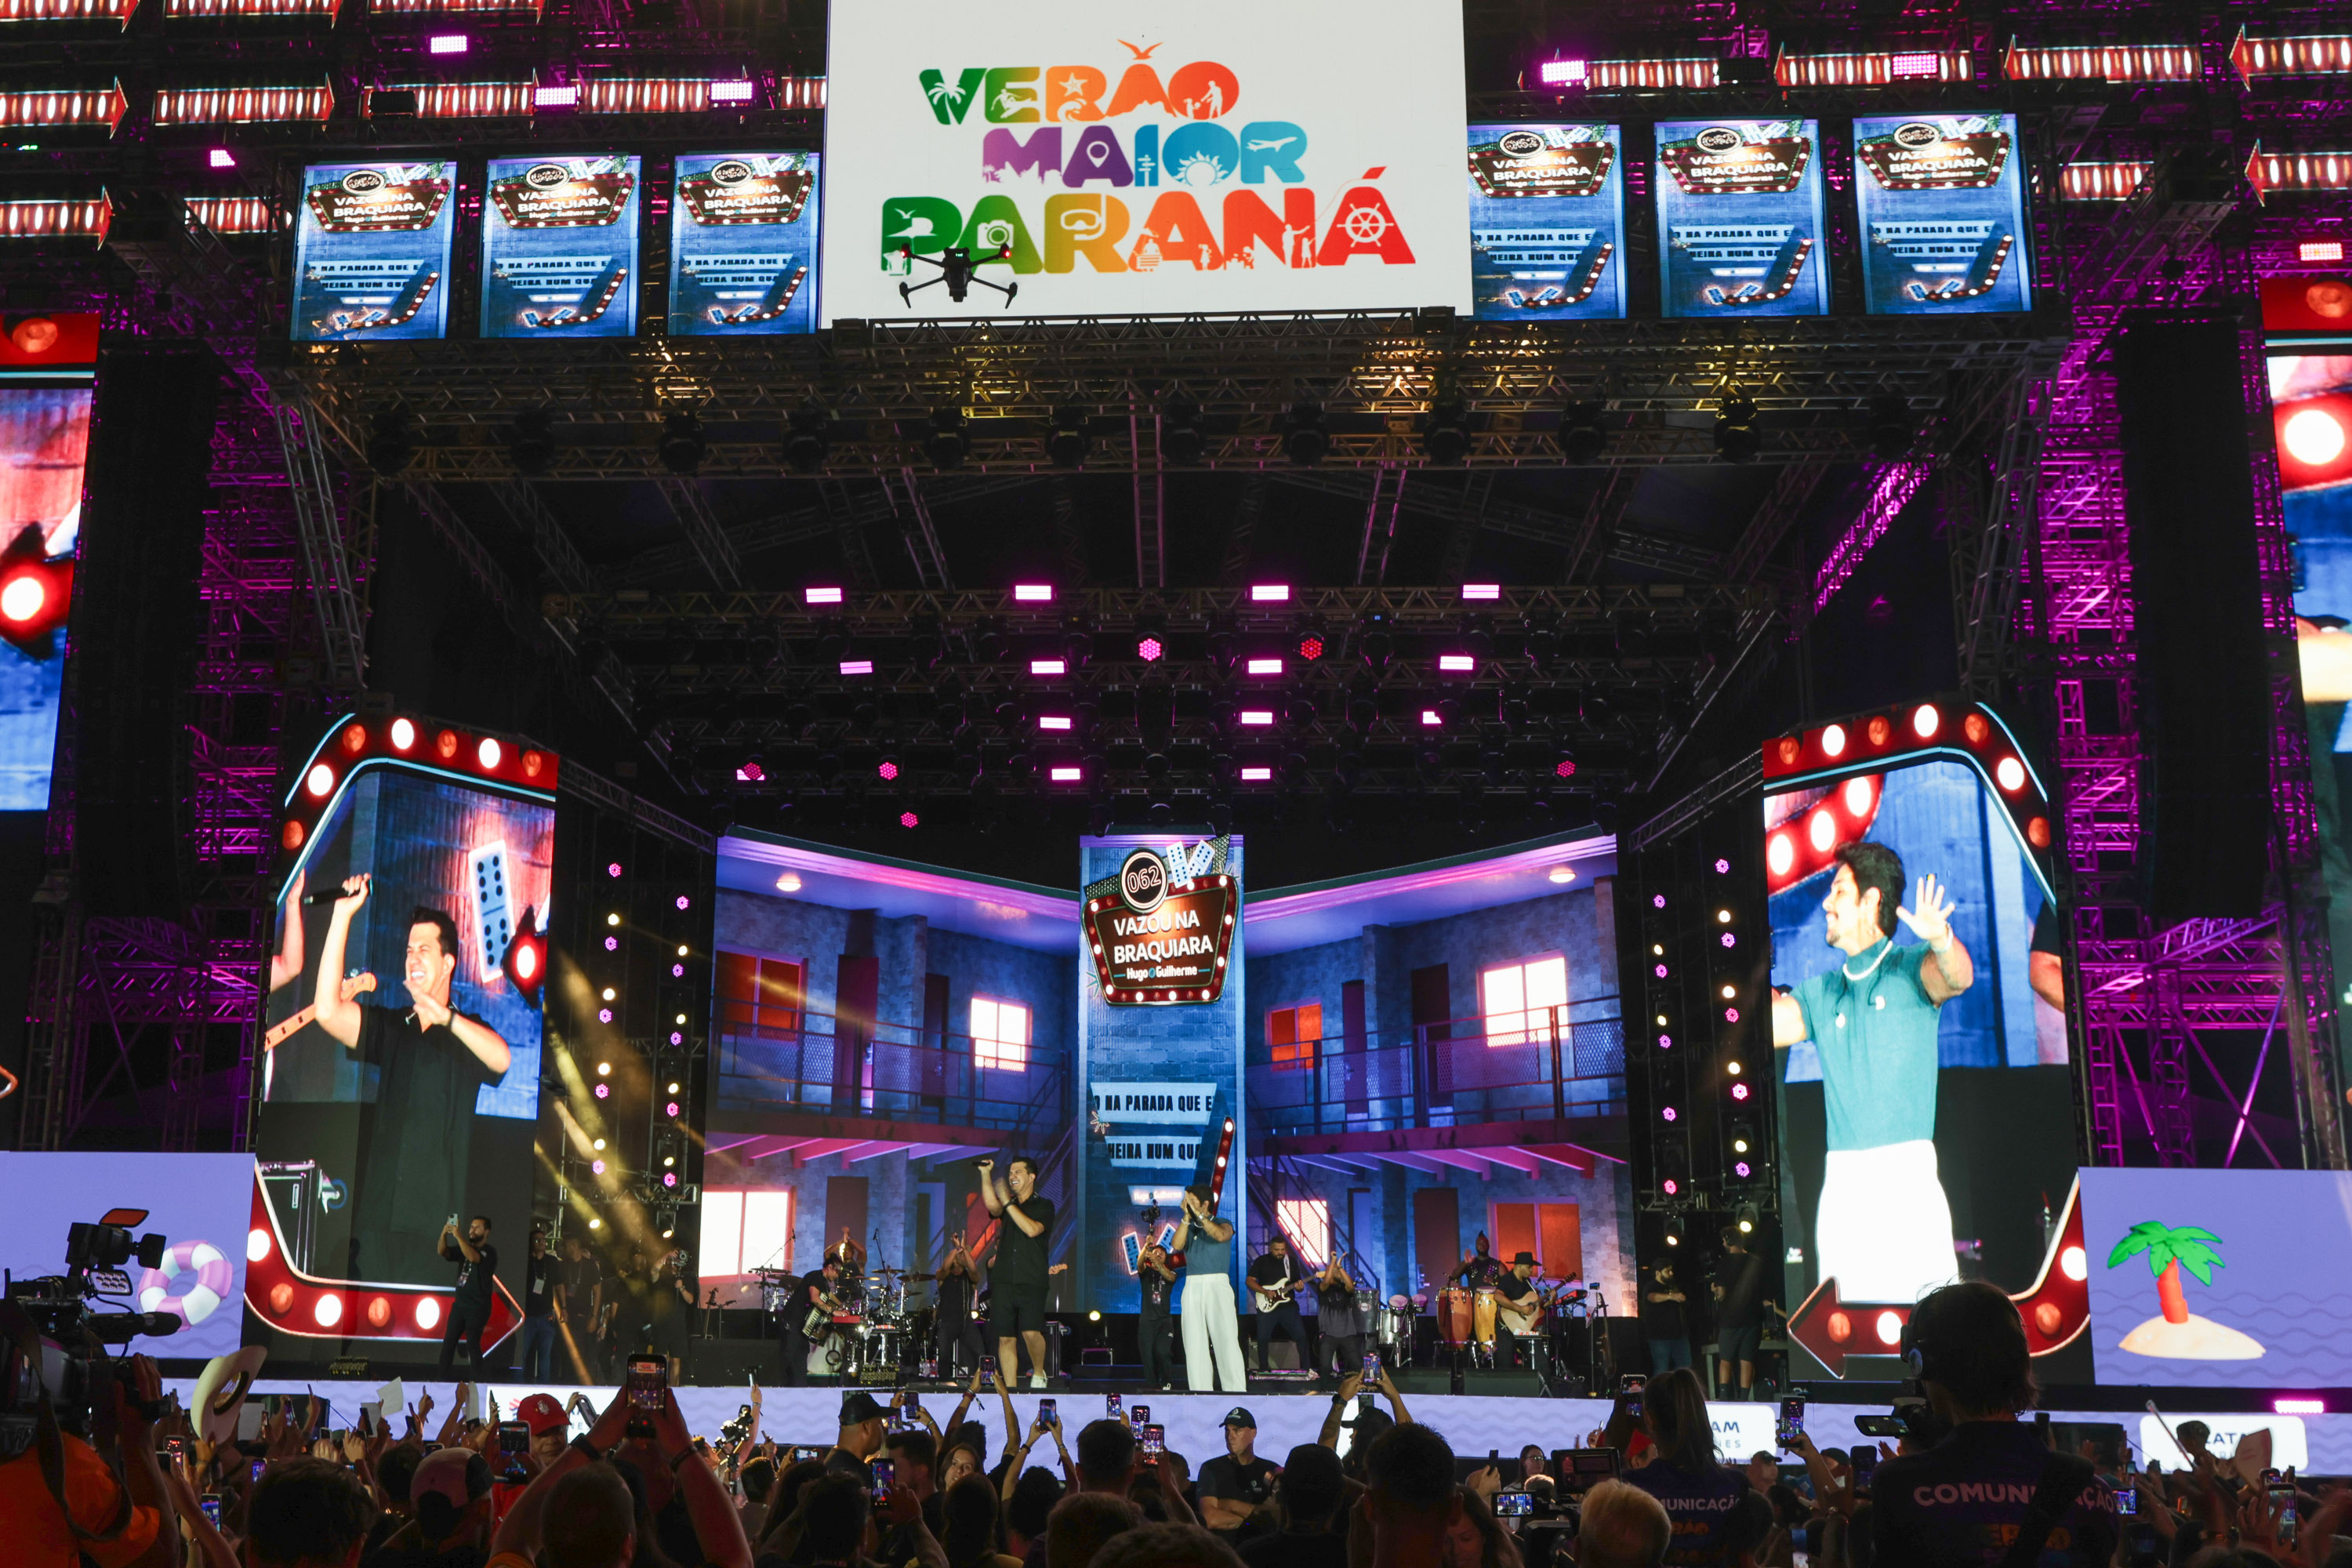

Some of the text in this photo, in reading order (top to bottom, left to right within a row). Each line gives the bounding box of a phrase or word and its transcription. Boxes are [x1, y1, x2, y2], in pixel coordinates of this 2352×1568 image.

[918, 38, 1240, 125] VERÃO
[982, 122, 1308, 188] MAIOR
[1750, 152, 1775, 161] NA
[1950, 147, 1974, 156] NA
[1553, 156, 1578, 165] NA
[1889, 158, 1988, 173] BRAQUIARA
[1494, 166, 1592, 180] BRAQUIARA
[1690, 162, 1788, 177] BRAQUIARA
[391, 192, 414, 201] NA
[575, 187, 599, 196] NA
[759, 184, 780, 194] NA
[517, 198, 611, 212] BRAQUIARA
[705, 194, 792, 209] BRAQUIARA
[333, 202, 426, 217] BRAQUIARA
[880, 165, 1416, 276] PARANÁ
[1127, 865, 1162, 893] 062
[1113, 909, 1200, 936] VAZOU NA
[1113, 935, 1214, 964] BRAQUIARA
[1127, 965, 1197, 982] Hugo Guilherme
[1105, 1094, 1121, 1111] NA
[1126, 1095, 1173, 1111] PARADA
[1178, 1095, 1201, 1112] QUE
[1147, 1143, 1174, 1160] NUM
